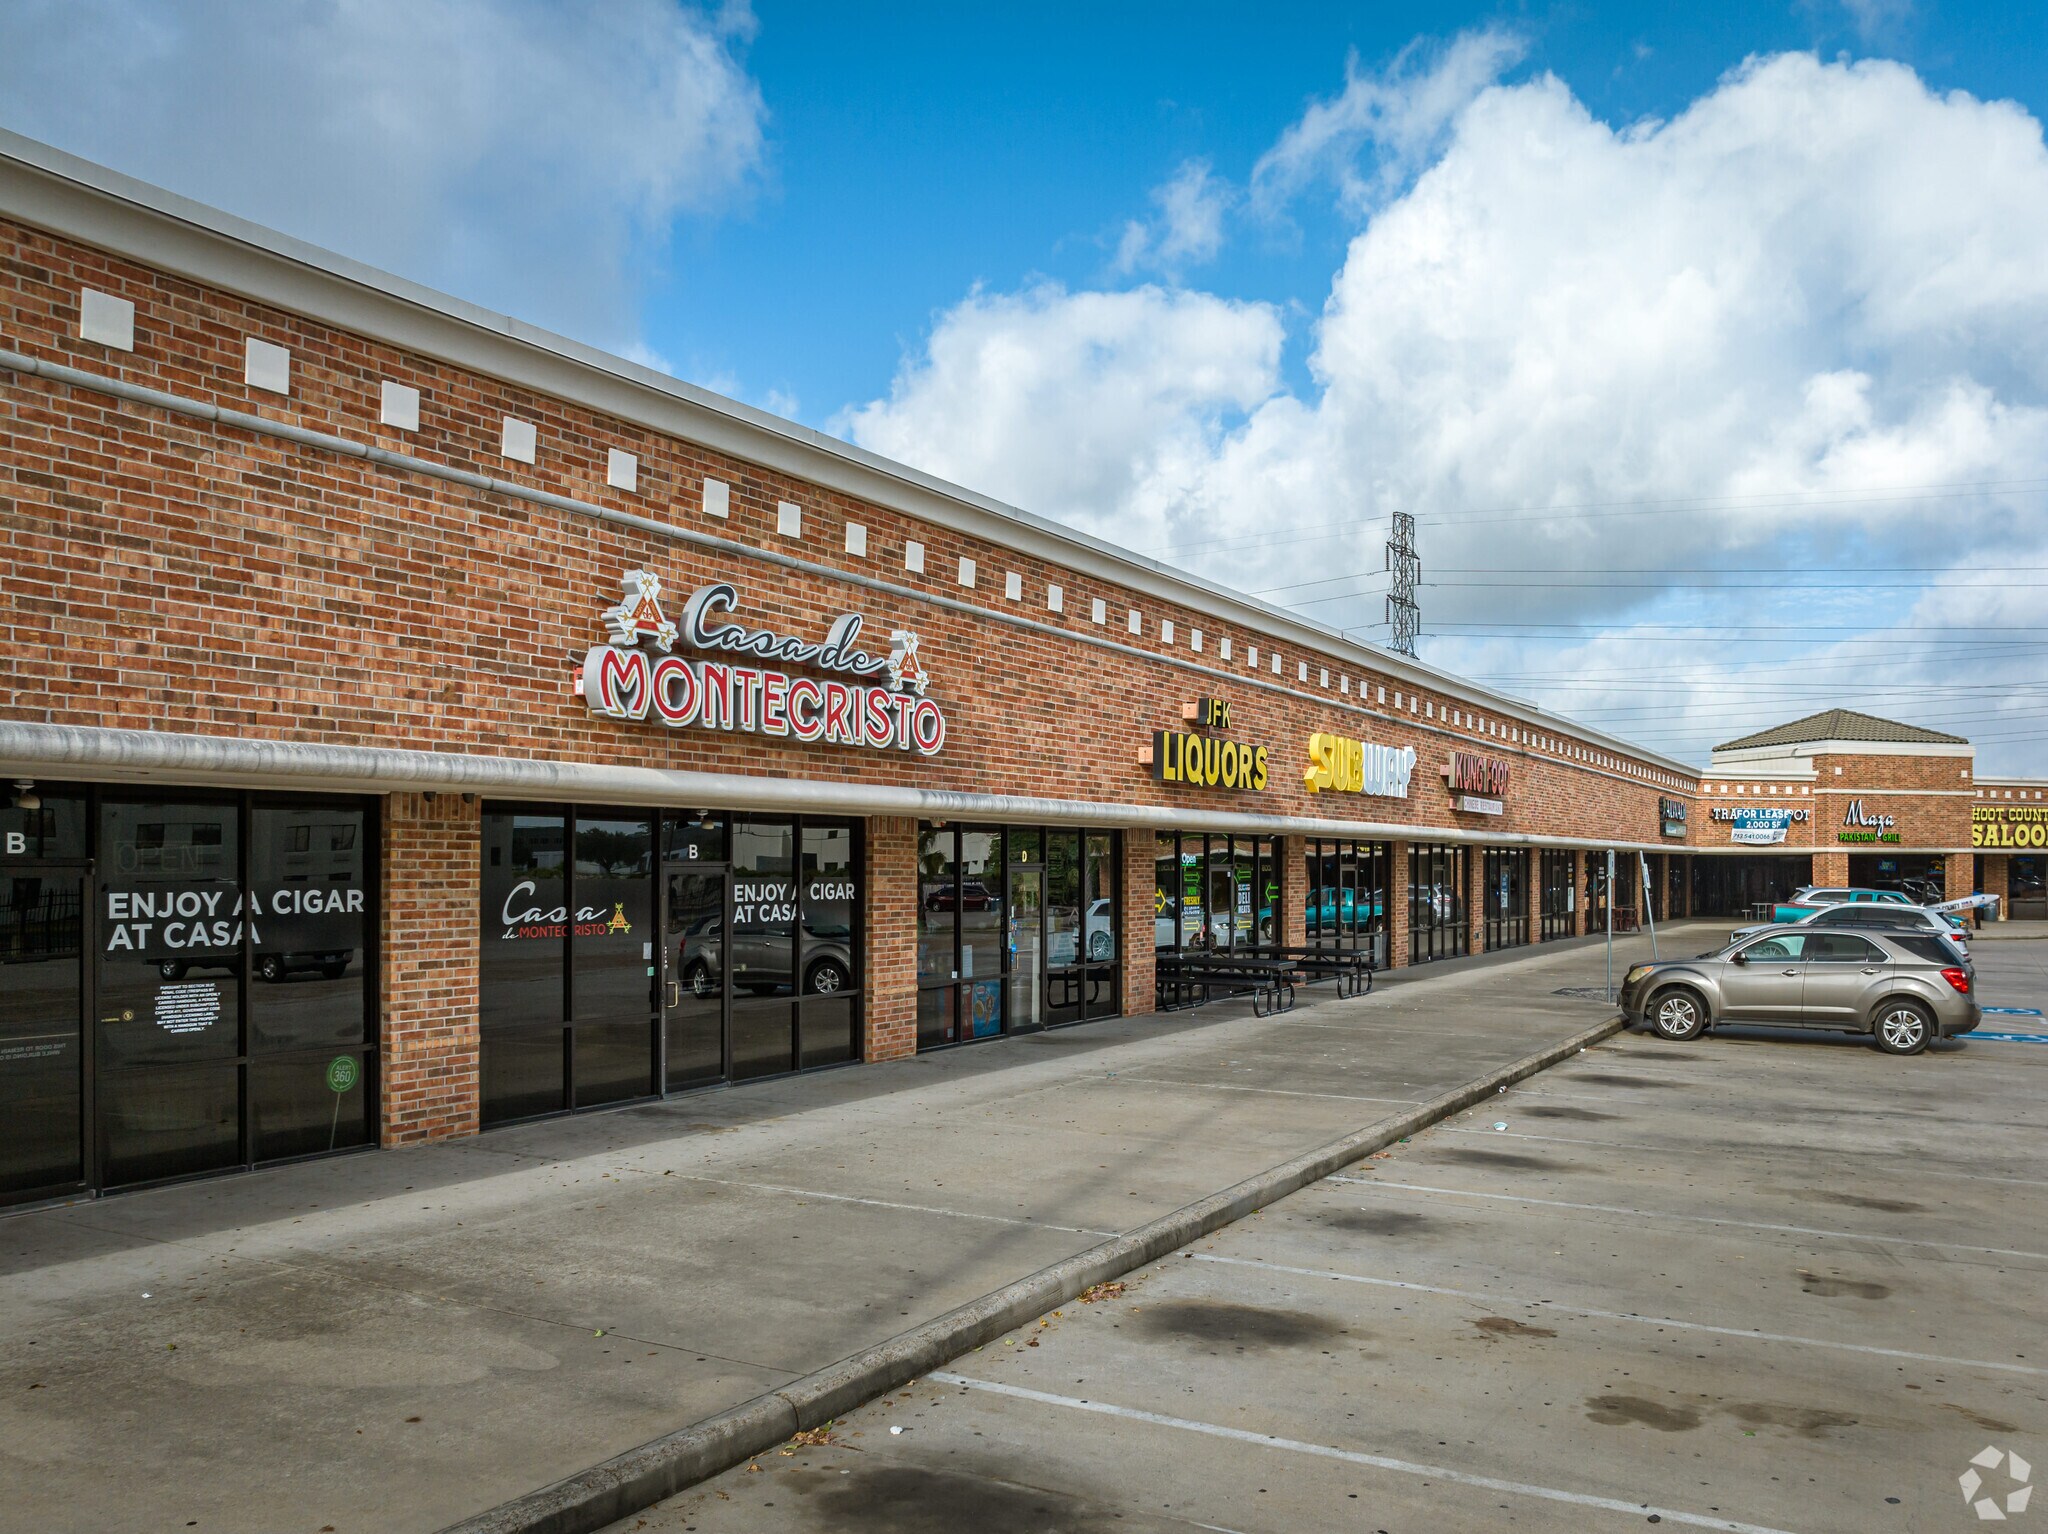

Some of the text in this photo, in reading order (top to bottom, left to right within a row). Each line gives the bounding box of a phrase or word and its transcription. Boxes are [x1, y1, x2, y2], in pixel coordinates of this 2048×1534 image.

[690, 585, 885, 672] Casa de
[597, 649, 946, 755] MONTECRISTO
[1205, 698, 1232, 728] JFK
[1162, 731, 1268, 791] LIQUORS
[1304, 733, 1417, 798] SUBWAY
[1456, 752, 1510, 795] KUNG FOOD
[1737, 809, 1756, 818] FOR
[1844, 799, 1895, 837] Maza
[1746, 821, 1781, 829] 2,000 SF
[1973, 824, 2048, 847] SALOO
[6, 832, 26, 854] B
[1840, 832, 1900, 842] PAKISTANI GRILL
[688, 844, 699, 859] B
[1021, 850, 1028, 863] D
[1181, 853, 1196, 866] Open
[502, 881, 607, 925] Casa
[734, 884, 787, 902] ENJOY
[810, 883, 855, 900] CIGAR
[109, 889, 364, 919] ENJOY A CIGAR
[734, 905, 755, 923] AT
[107, 922, 262, 950] AT CASA
[502, 924, 606, 939] de MONTECRISTO
[334, 1070, 351, 1082] 360
